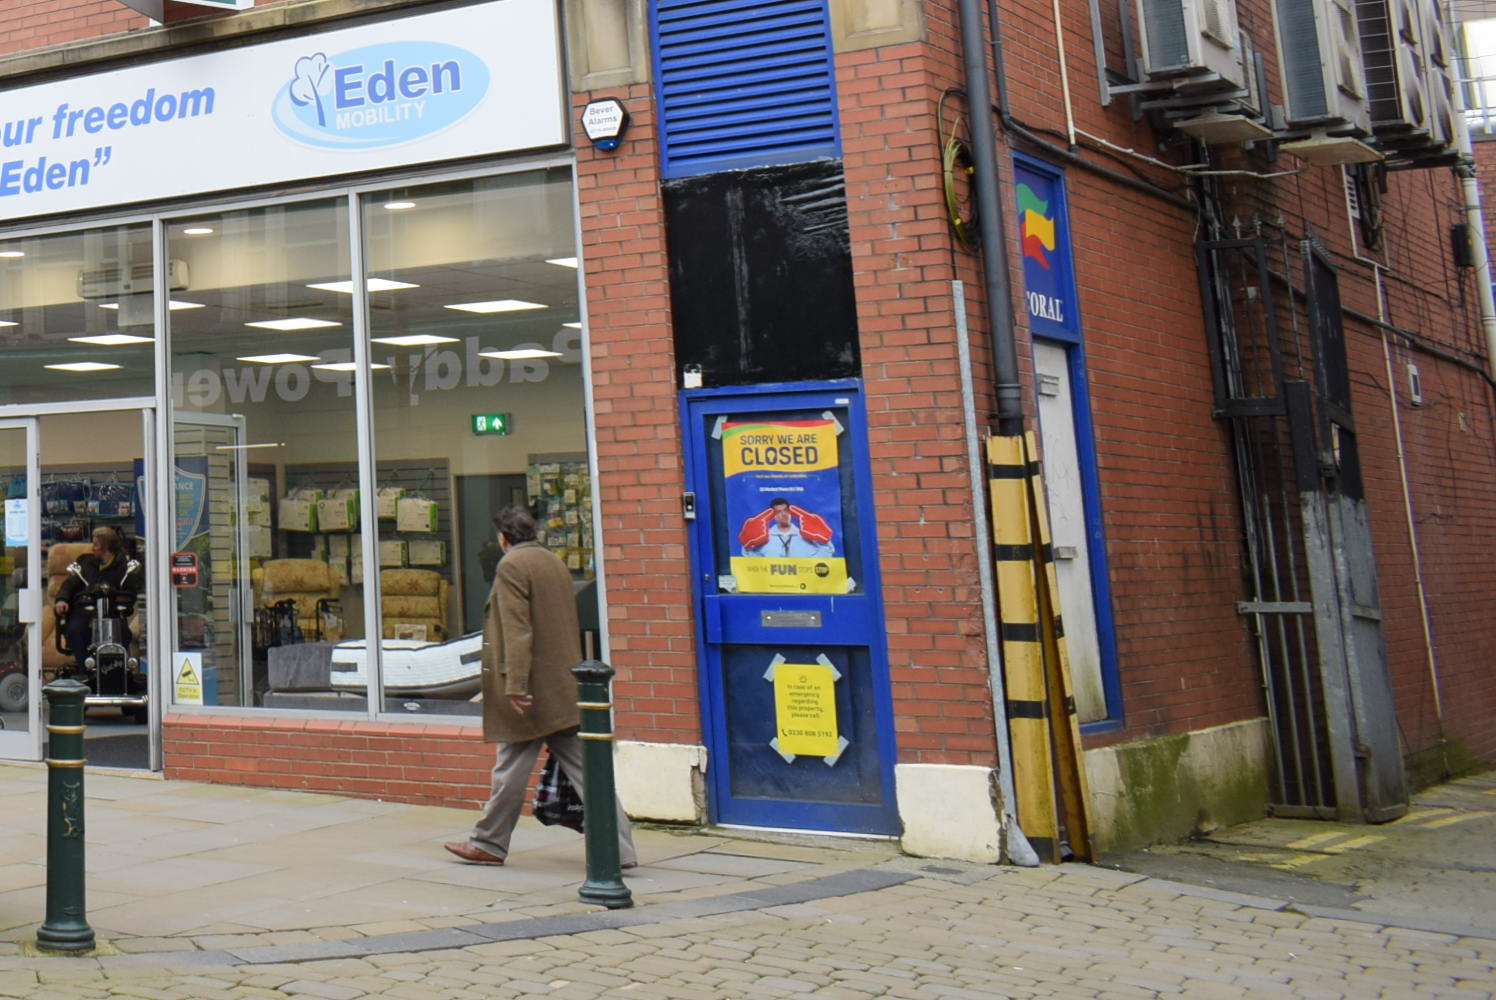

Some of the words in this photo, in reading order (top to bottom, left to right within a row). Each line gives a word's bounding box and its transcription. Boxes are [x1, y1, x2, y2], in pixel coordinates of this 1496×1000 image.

[334, 60, 461, 110] Eden
[52, 86, 216, 139] freedom
[336, 101, 427, 130] MOBILITY
[1027, 291, 1063, 322] ORAL
[739, 434, 775, 446] SORRY
[777, 434, 793, 445] WE
[796, 433, 817, 444] ARE
[741, 446, 818, 465] CLOSED
[770, 564, 797, 575] FUN
